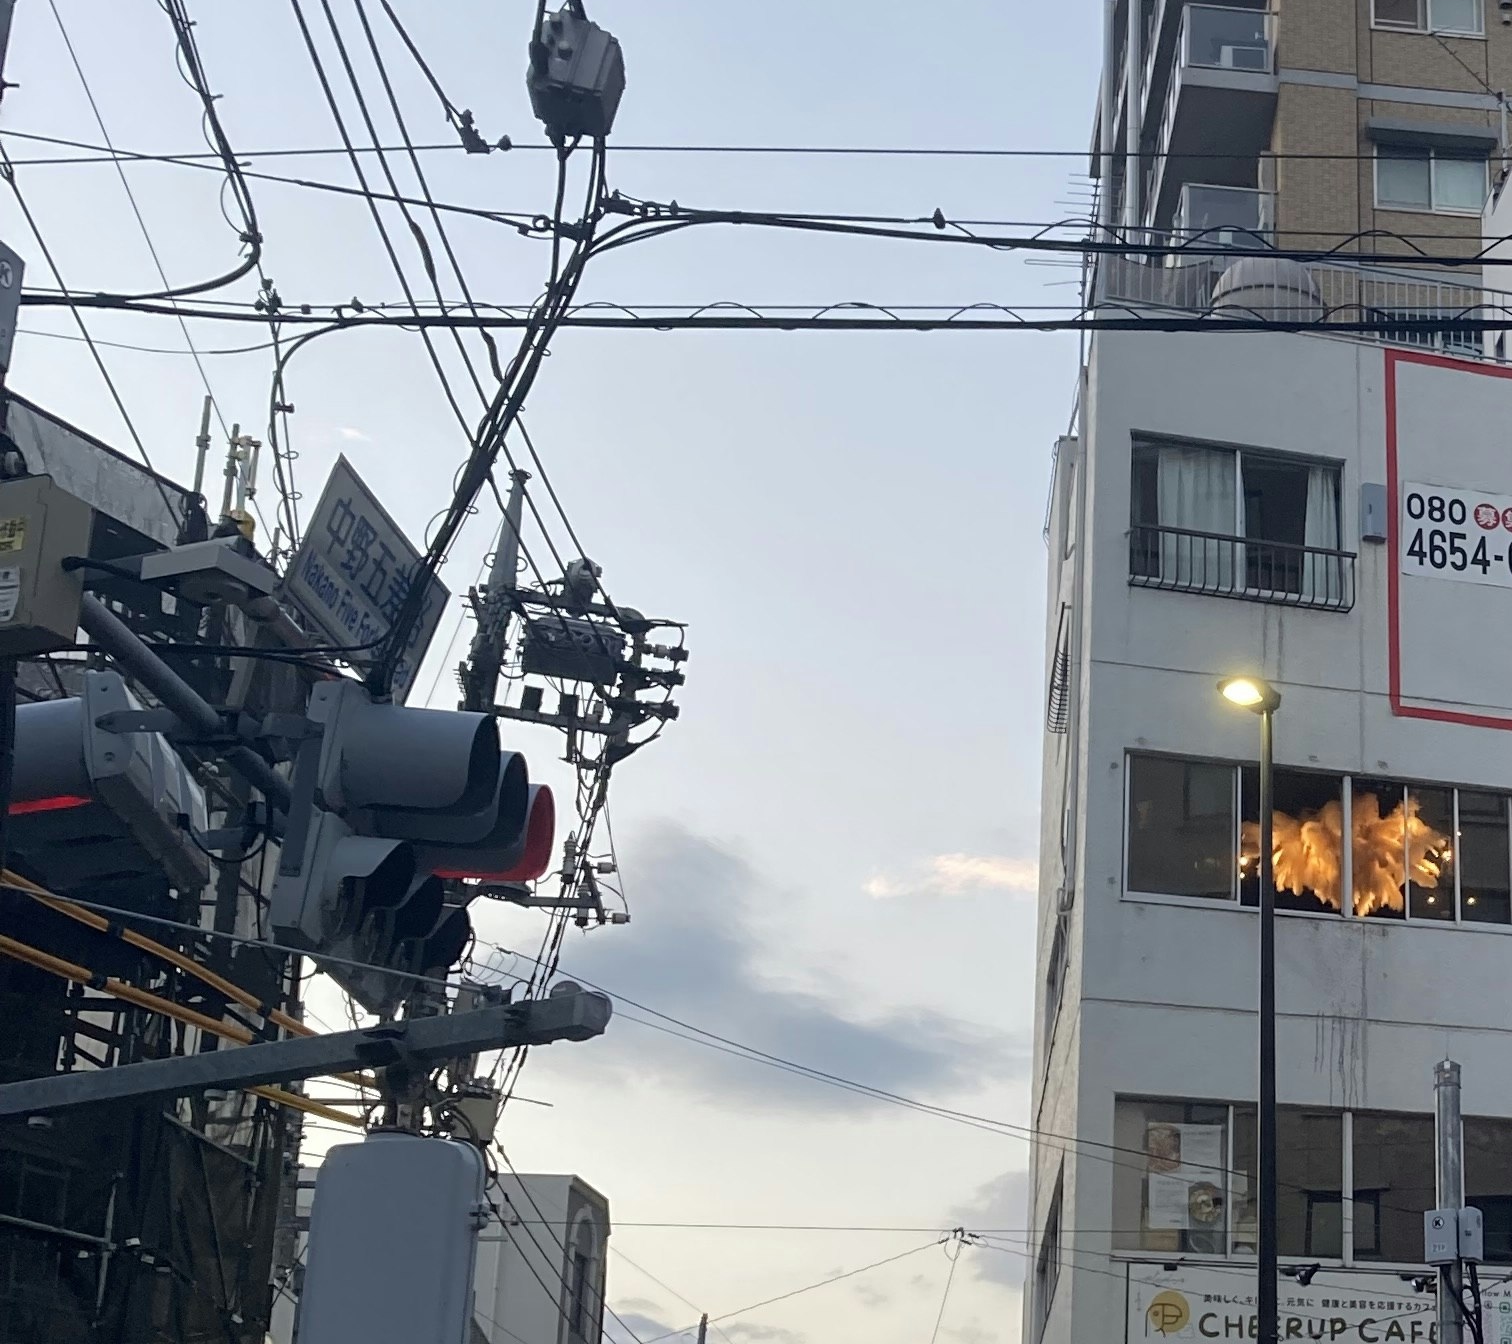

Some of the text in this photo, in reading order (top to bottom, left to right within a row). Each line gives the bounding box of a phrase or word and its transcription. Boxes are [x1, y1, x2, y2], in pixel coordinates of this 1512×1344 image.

[1406, 492, 1467, 525] 080
[302, 548, 341, 609] Nakano
[336, 589, 360, 632] Five
[1199, 1312, 1347, 1342] CHERUP
